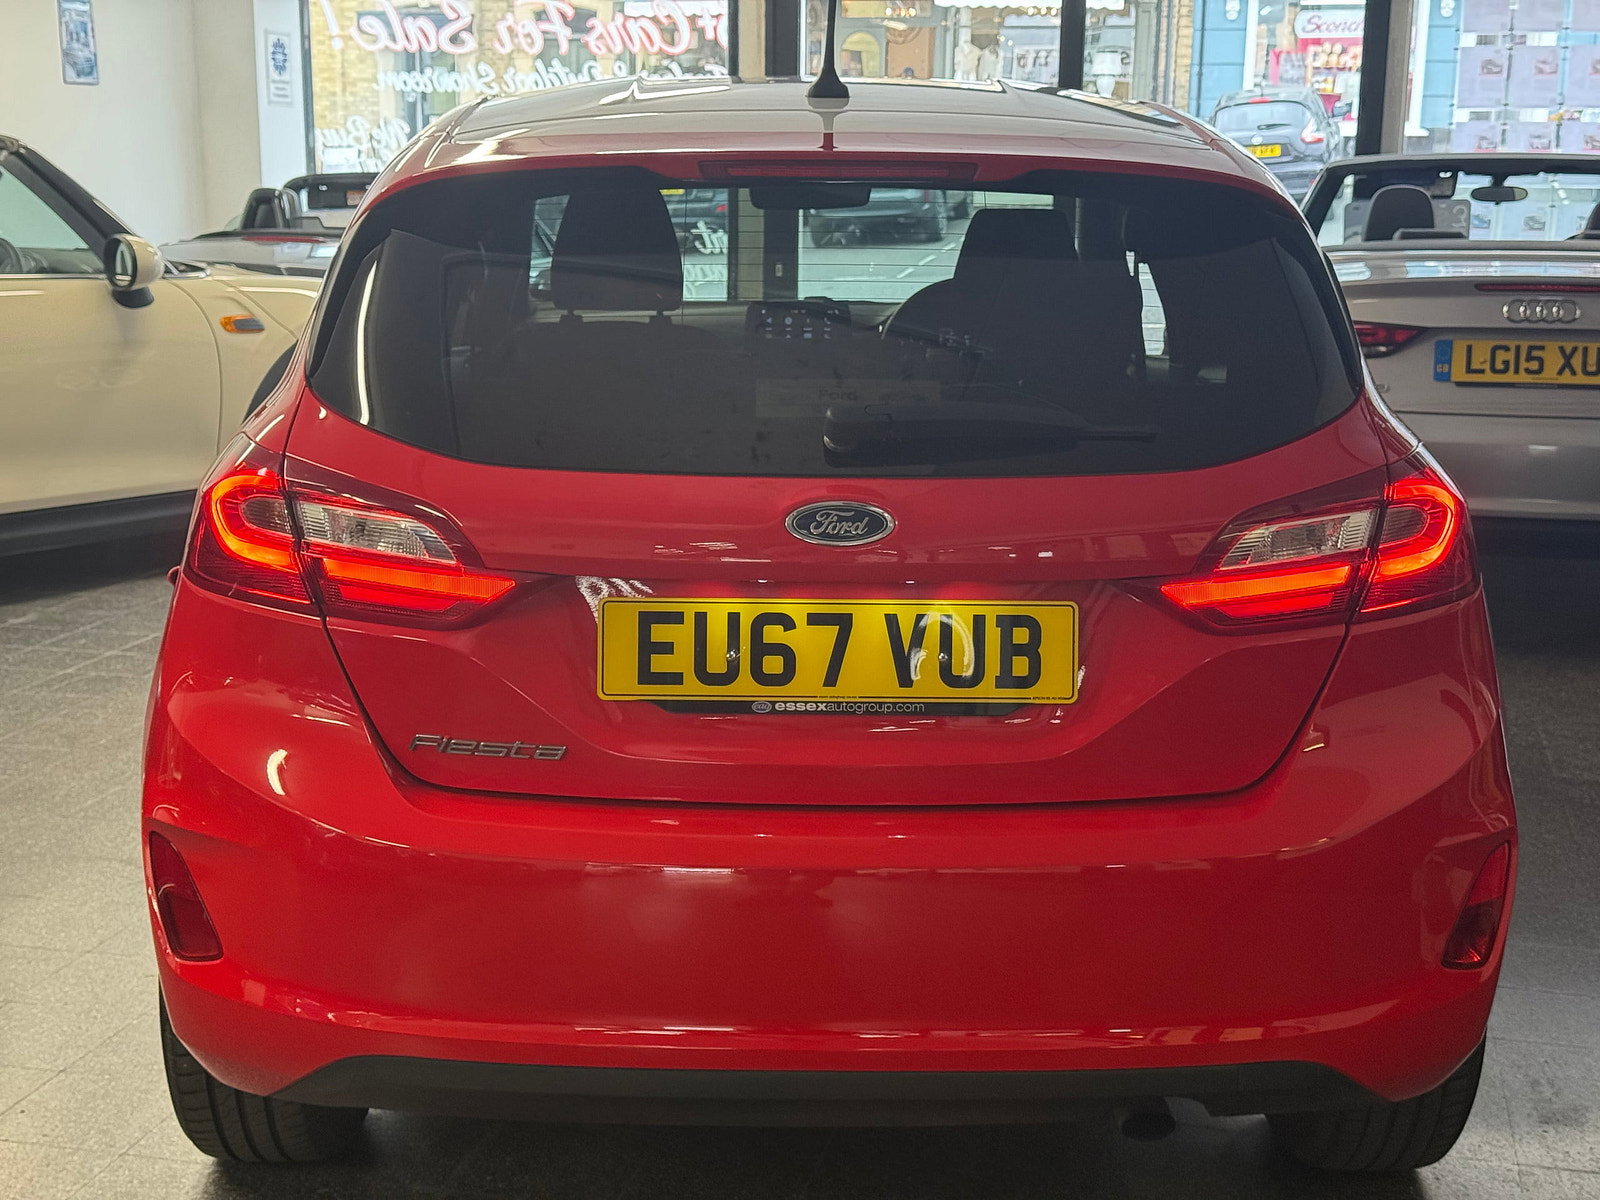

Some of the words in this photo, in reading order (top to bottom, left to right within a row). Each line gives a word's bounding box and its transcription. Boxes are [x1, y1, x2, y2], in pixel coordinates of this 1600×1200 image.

[1465, 344, 1545, 375] LG15
[810, 510, 870, 535] Ford
[637, 611, 854, 688] EU67
[884, 613, 1042, 689] VUB
[774, 702, 925, 714] essexautogroup.com
[409, 733, 567, 760] Fiesta
